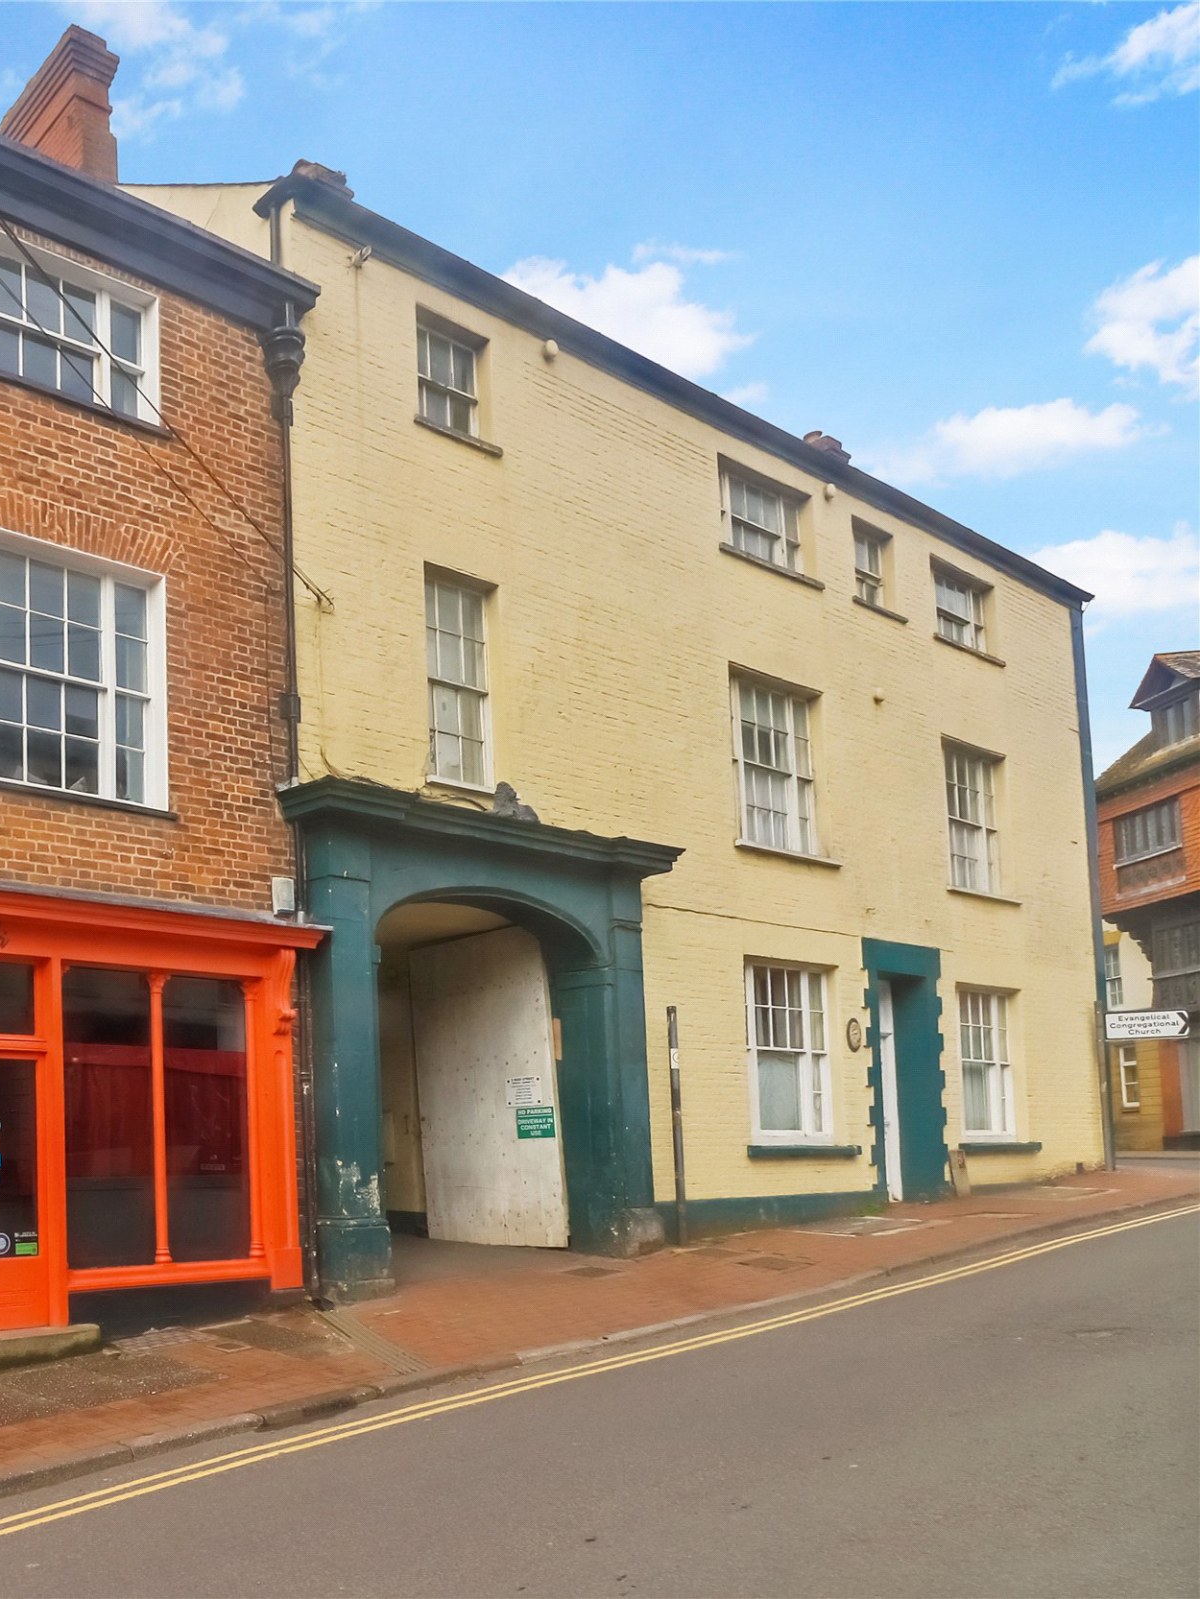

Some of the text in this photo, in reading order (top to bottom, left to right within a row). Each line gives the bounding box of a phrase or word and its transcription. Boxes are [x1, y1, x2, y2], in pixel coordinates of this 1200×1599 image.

[1117, 1014, 1170, 1022] Evangelical
[1109, 1020, 1180, 1029] Congregational
[520, 1123, 551, 1131] CONSTANT
